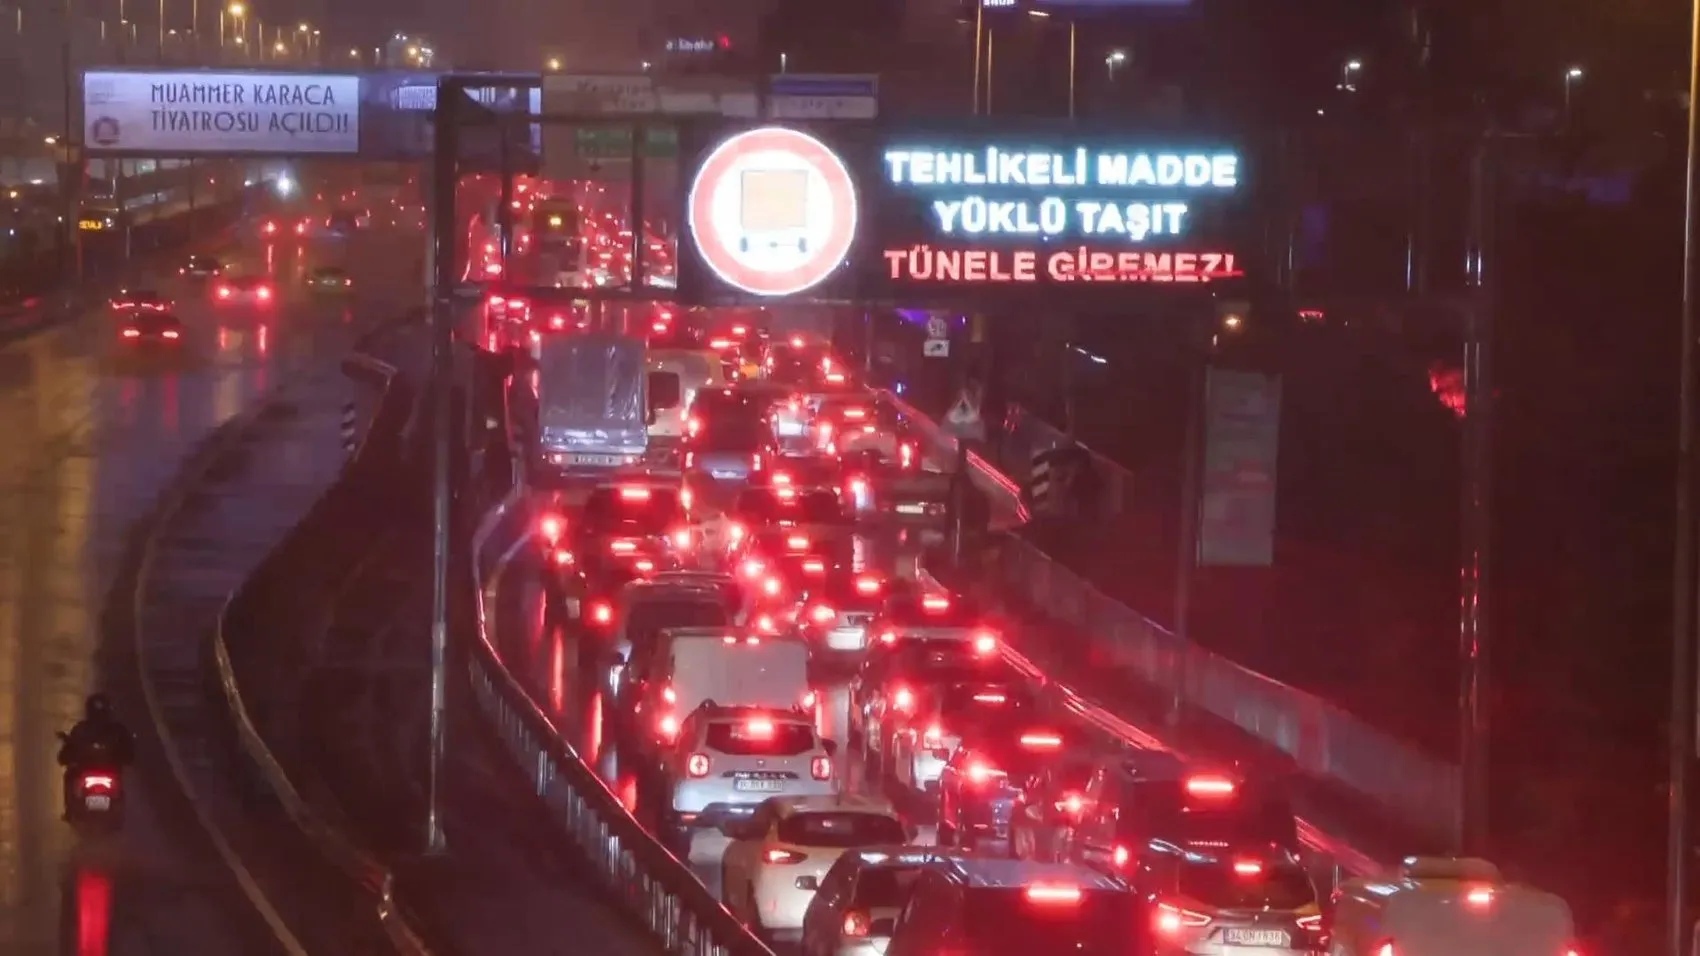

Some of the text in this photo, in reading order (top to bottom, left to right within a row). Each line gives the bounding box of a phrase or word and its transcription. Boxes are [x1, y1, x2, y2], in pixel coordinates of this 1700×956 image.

[151, 84, 335, 106] MUAMMER KARACA
[150, 106, 349, 136] TİYATROSU AÇILDI!
[885, 146, 1238, 187] TEHLİKELİ MADDE
[935, 196, 1188, 241] YÜKLÜ TAŞIT
[884, 245, 1036, 281] TÜNELE
